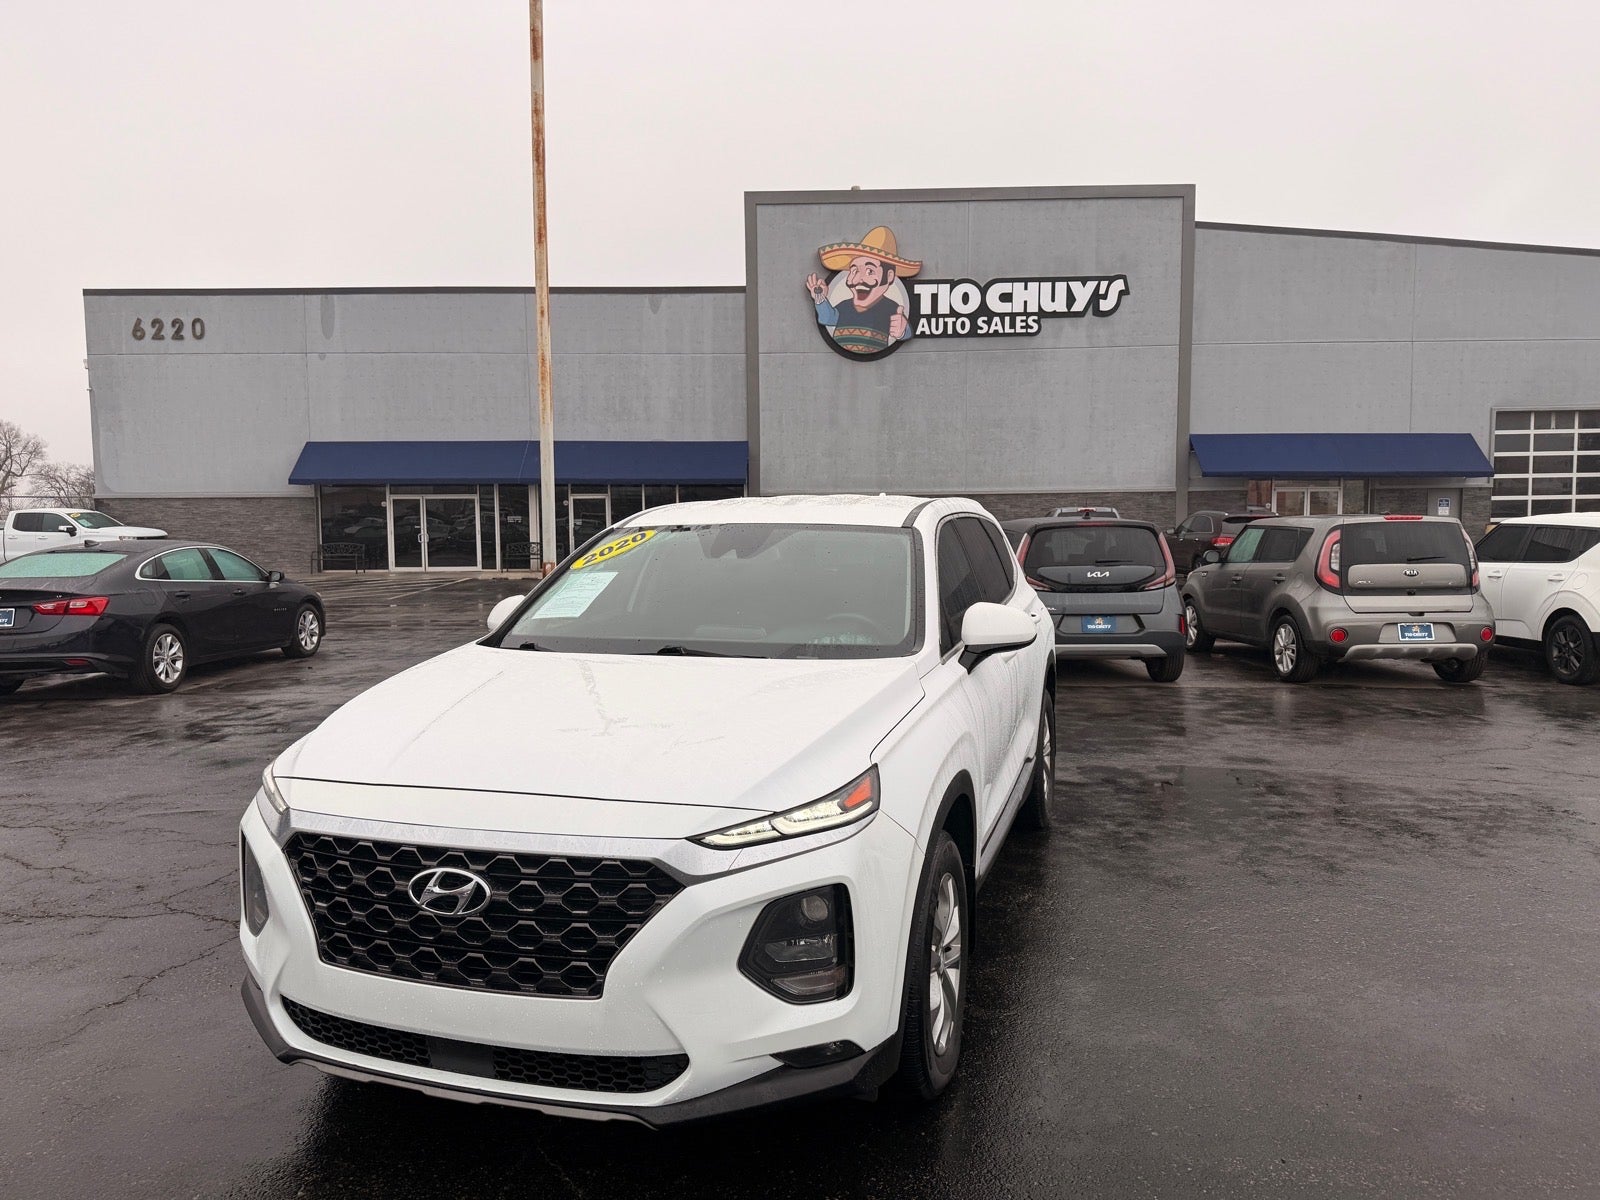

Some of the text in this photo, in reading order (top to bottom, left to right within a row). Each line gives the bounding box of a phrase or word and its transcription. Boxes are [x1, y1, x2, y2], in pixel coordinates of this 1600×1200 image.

[914, 278, 1125, 315] TIO CHUY'S
[132, 317, 206, 341] 6220
[916, 315, 1039, 336] AUTO SALES
[582, 532, 647, 566] 2020
